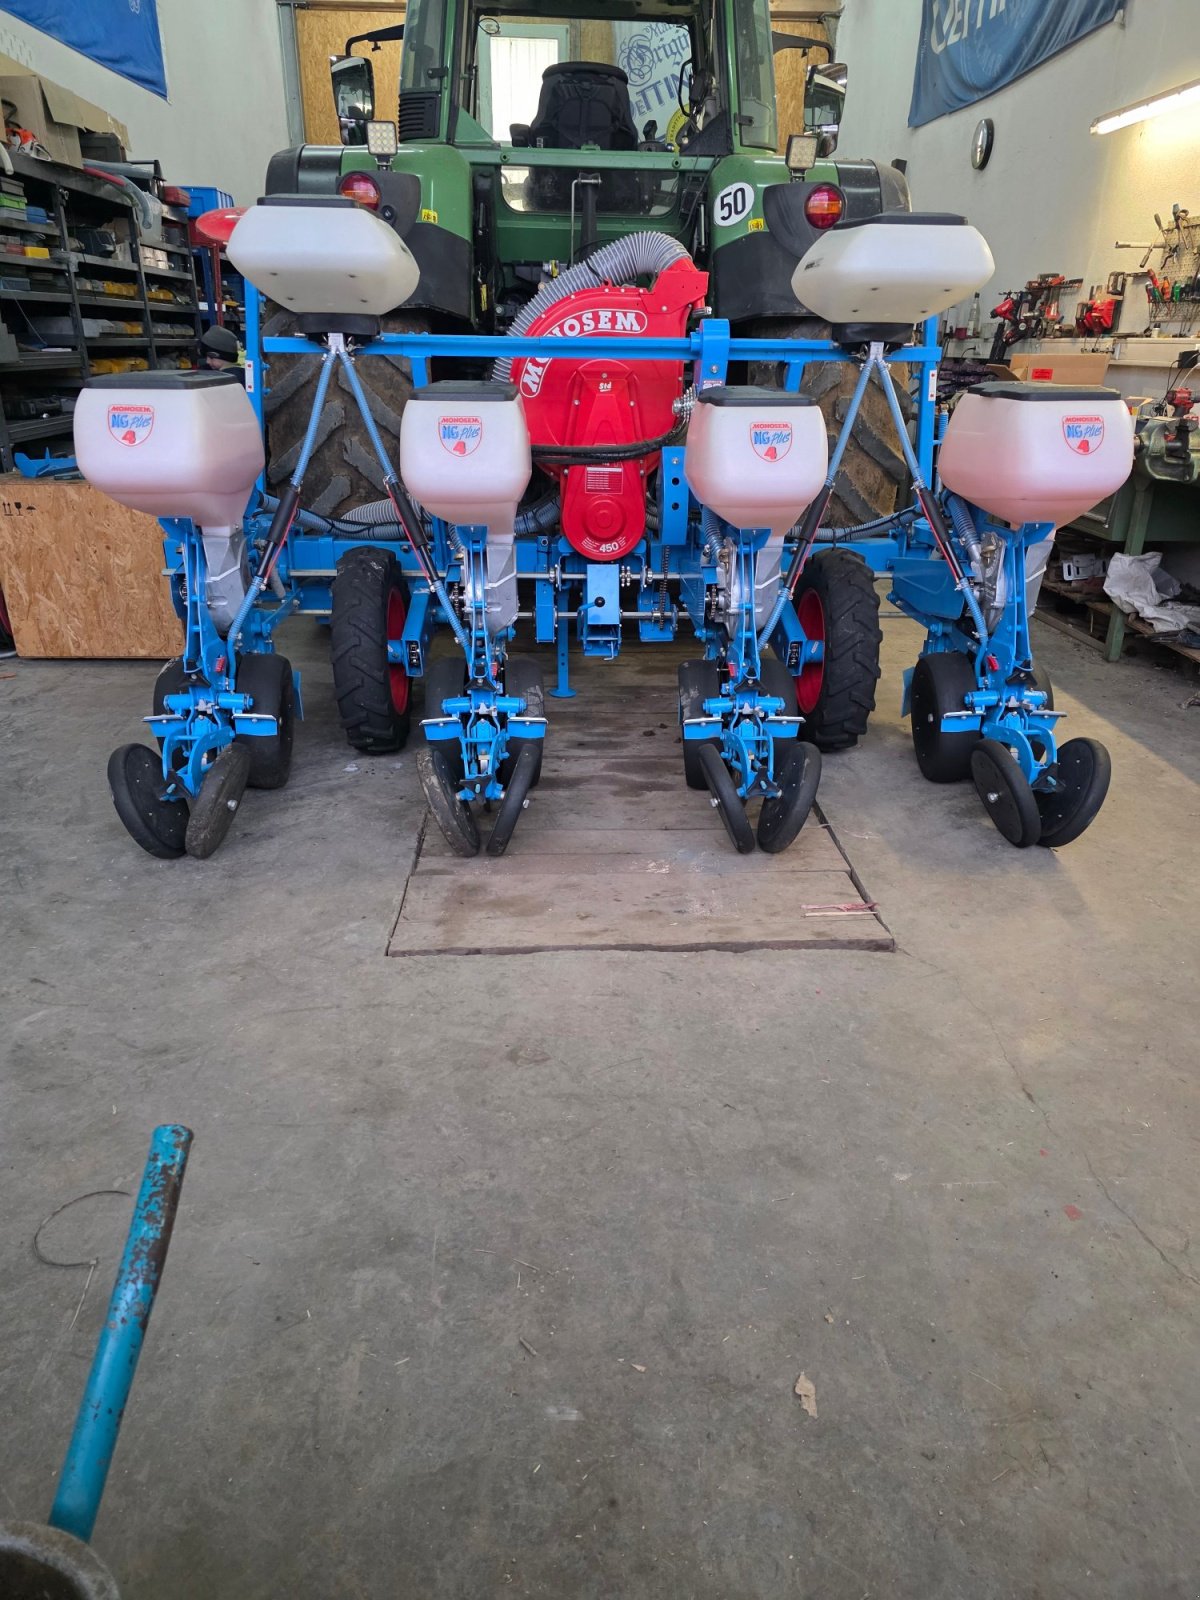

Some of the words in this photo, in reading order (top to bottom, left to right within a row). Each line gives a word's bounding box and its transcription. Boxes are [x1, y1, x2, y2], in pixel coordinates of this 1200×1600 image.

[720, 187, 746, 221] 50
[522, 311, 640, 393] MOSEM
[599, 541, 619, 552] 450
